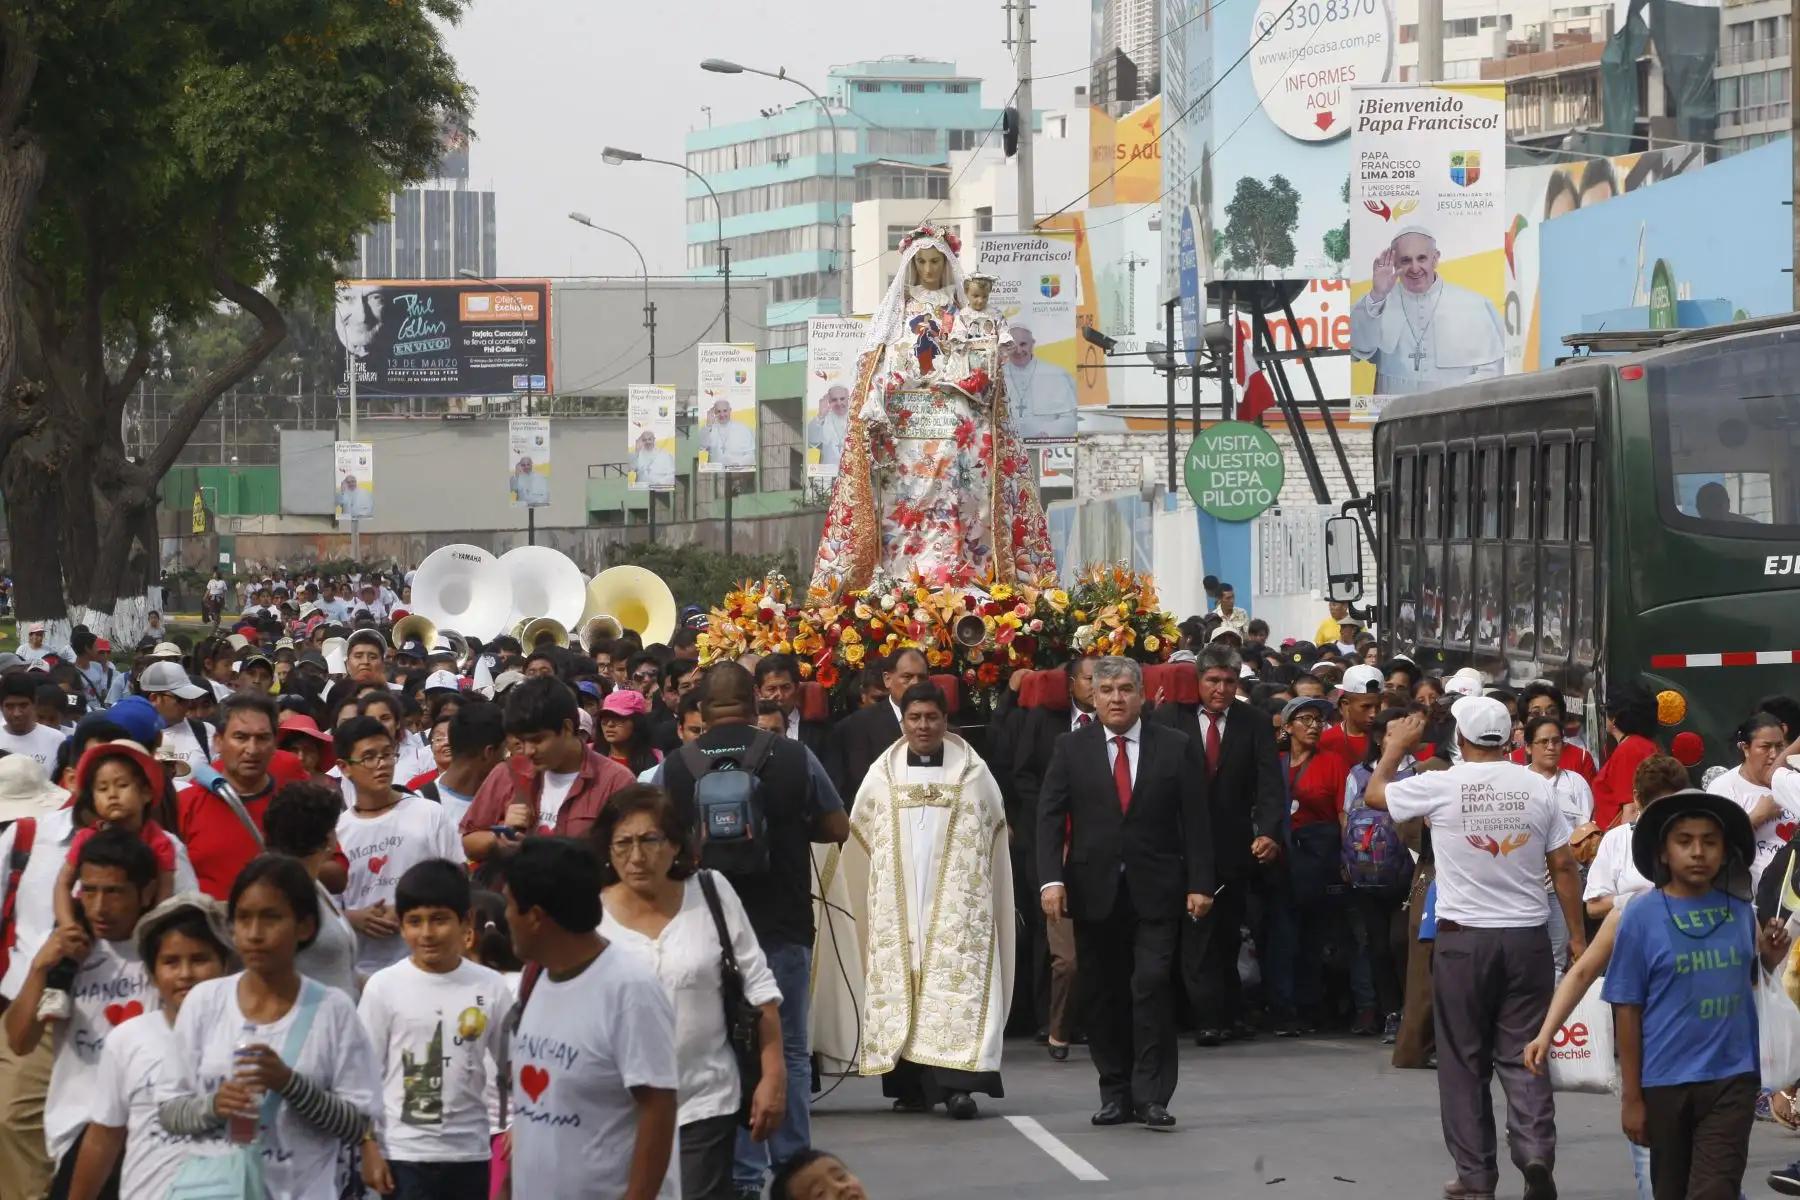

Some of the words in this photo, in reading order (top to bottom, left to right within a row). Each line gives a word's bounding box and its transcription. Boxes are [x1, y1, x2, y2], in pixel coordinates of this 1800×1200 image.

[1284, 3, 1320, 31] 330
[1259, 32, 1382, 65] www.ingocasa.com.pe
[1285, 65, 1356, 92] INFORMES
[1306, 87, 1341, 109] AQUÍ
[1358, 96, 1463, 115] ¡Bienvenido
[1358, 116, 1403, 135] Papa
[1407, 114, 1499, 131] Francisco!
[1131, 142, 1161, 159] AQU
[1361, 151, 1389, 160] PAPA
[1361, 160, 1421, 170] FRANCISCO
[1361, 171, 1388, 180] LIMA
[1391, 170, 1416, 179] 2018
[980, 239, 1049, 252] ¡Bienvenido
[980, 252, 1010, 264] Papa
[1011, 251, 1071, 262] Francisco!
[393, 292, 435, 319] Phil
[494, 303, 534, 312] Exclusiva
[472, 330, 493, 338] Tarjeta
[812, 330, 834, 339] Papa
[835, 330, 867, 338] Francis
[396, 343, 414, 354] EN
[415, 338, 449, 352] VIVO!
[387, 359, 398, 368] 13
[403, 359, 417, 368] DE
[421, 358, 458, 367] MARZO
[343, 371, 378, 383] LEENDARY
[1204, 435, 1262, 451] VISITA
[1192, 452, 1279, 470] NUESTRO
[1211, 470, 1263, 488] DEPA
[1202, 488, 1272, 507] PILOTO
[458, 552, 482, 563] YAMAHA
[1461, 783, 1494, 792] PAPA
[1461, 791, 1530, 803] FRANCISCO
[1461, 803, 1494, 813] LIMA
[1498, 801, 1525, 811] 2018
[1470, 817, 1501, 825] UNIDOS
[1483, 823, 1531, 832] ESPERANZA
[1673, 906, 1735, 930] LET'S
[1676, 945, 1742, 974] CHILL
[72, 974, 144, 1002] MANCH
[1700, 995, 1741, 1019] OUT
[515, 1033, 579, 1070] ANCHAY
[1550, 1048, 1591, 1060] oechsle
